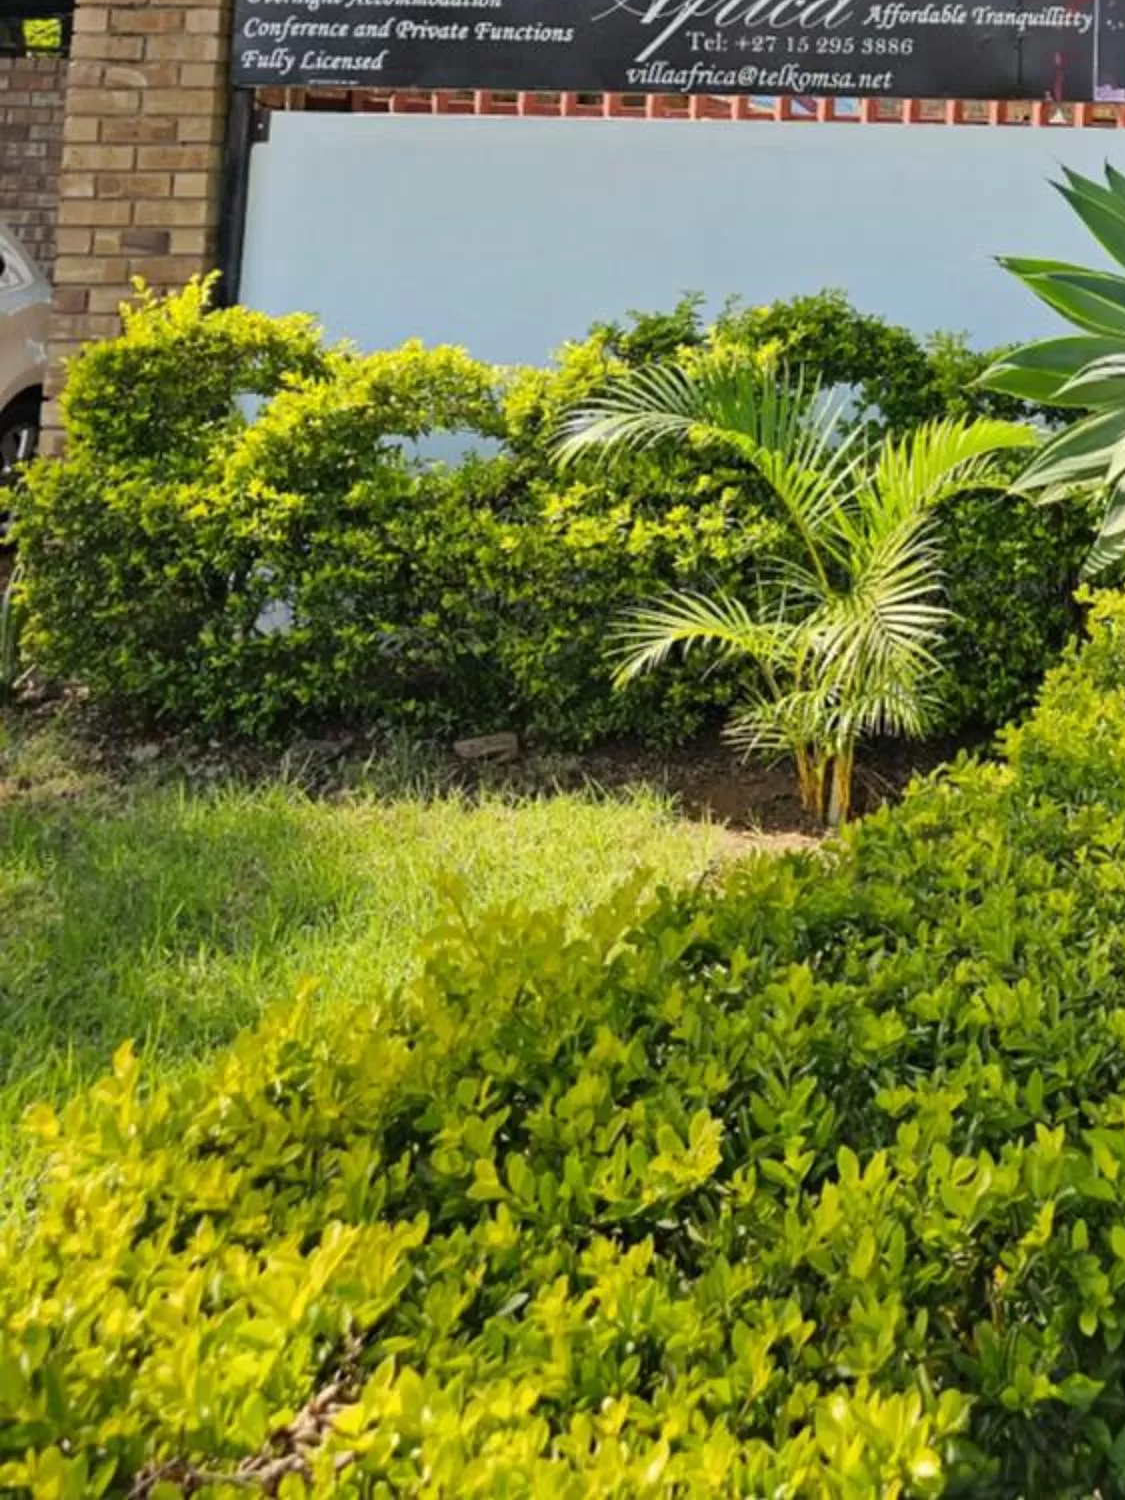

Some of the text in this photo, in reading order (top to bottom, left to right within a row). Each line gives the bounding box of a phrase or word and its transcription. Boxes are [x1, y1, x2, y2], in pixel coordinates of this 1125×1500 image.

[243, 14, 574, 43] Conference and Private Functions
[862, 2, 968, 29] Affordable
[686, 30, 914, 56] Tel: +27 15 295 3886
[240, 48, 390, 76] Fully Licensed
[625, 61, 893, 93] villaafrica@telkomsa.net
